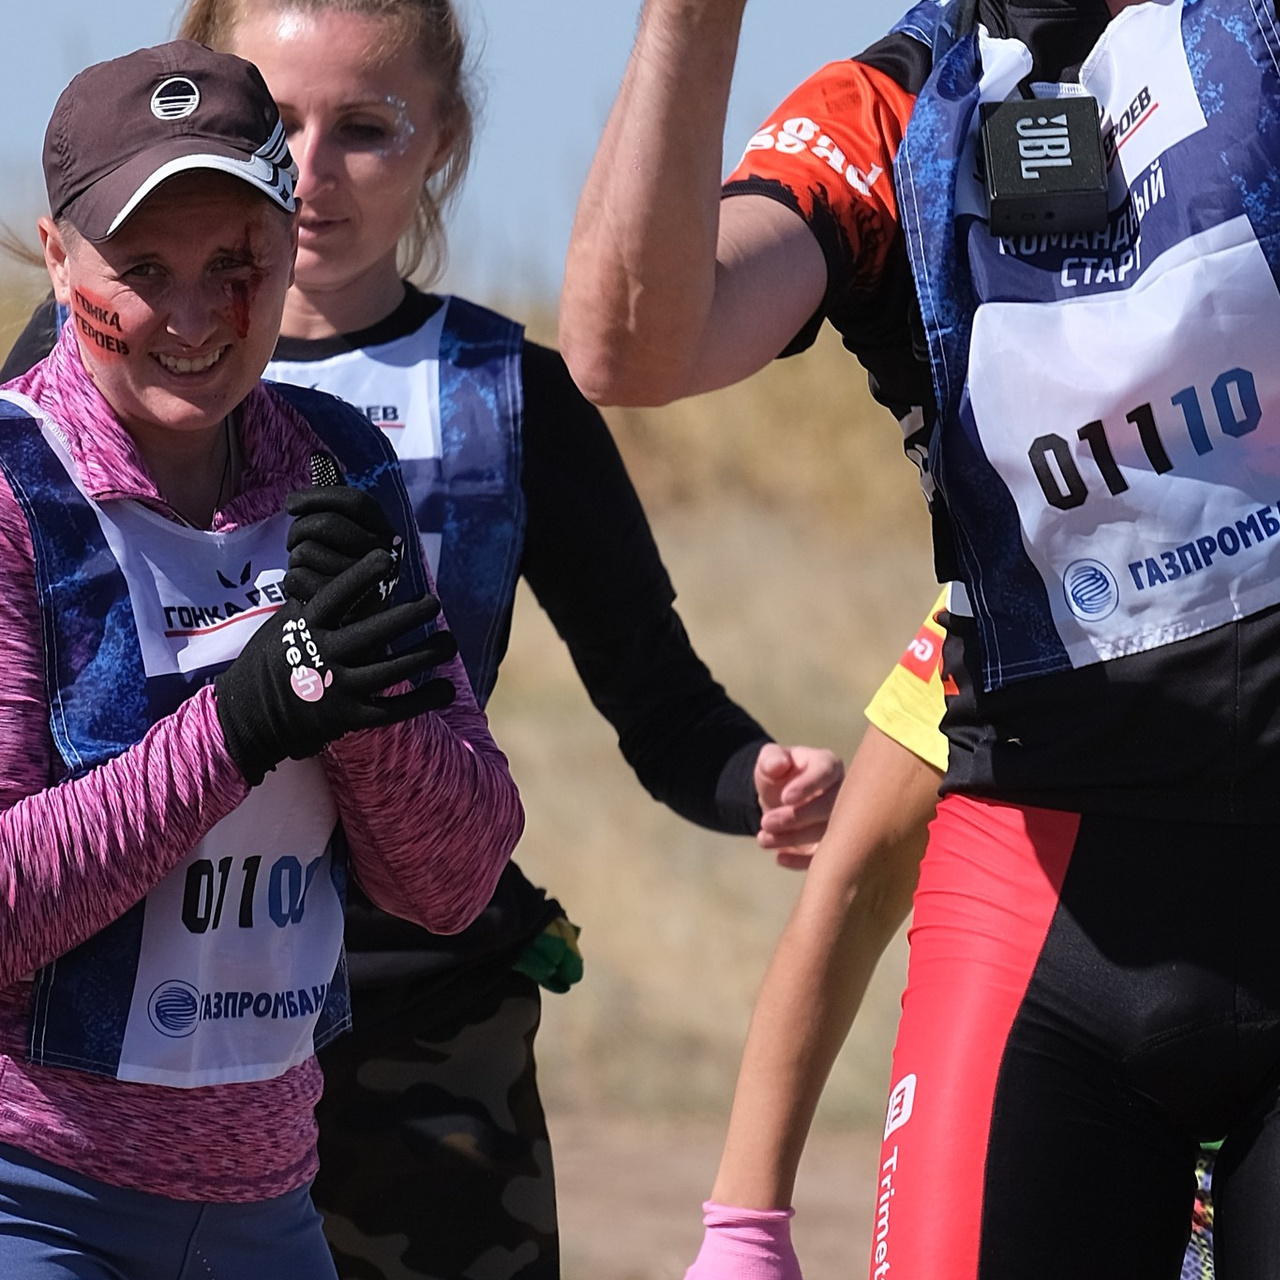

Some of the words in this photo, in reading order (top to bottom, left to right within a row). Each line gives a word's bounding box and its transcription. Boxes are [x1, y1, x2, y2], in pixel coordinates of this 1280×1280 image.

[1016, 114, 1073, 180] JBL
[1060, 235, 1142, 288] СТАРТ
[74, 289, 123, 332] ГОНКА
[74, 310, 130, 355] ГЕРОЕВ
[1027, 367, 1263, 511] 01110
[282, 619, 318, 697] fresh
[297, 618, 324, 669] OZON
[199, 983, 330, 1021] ГАЗПРОМБАН
